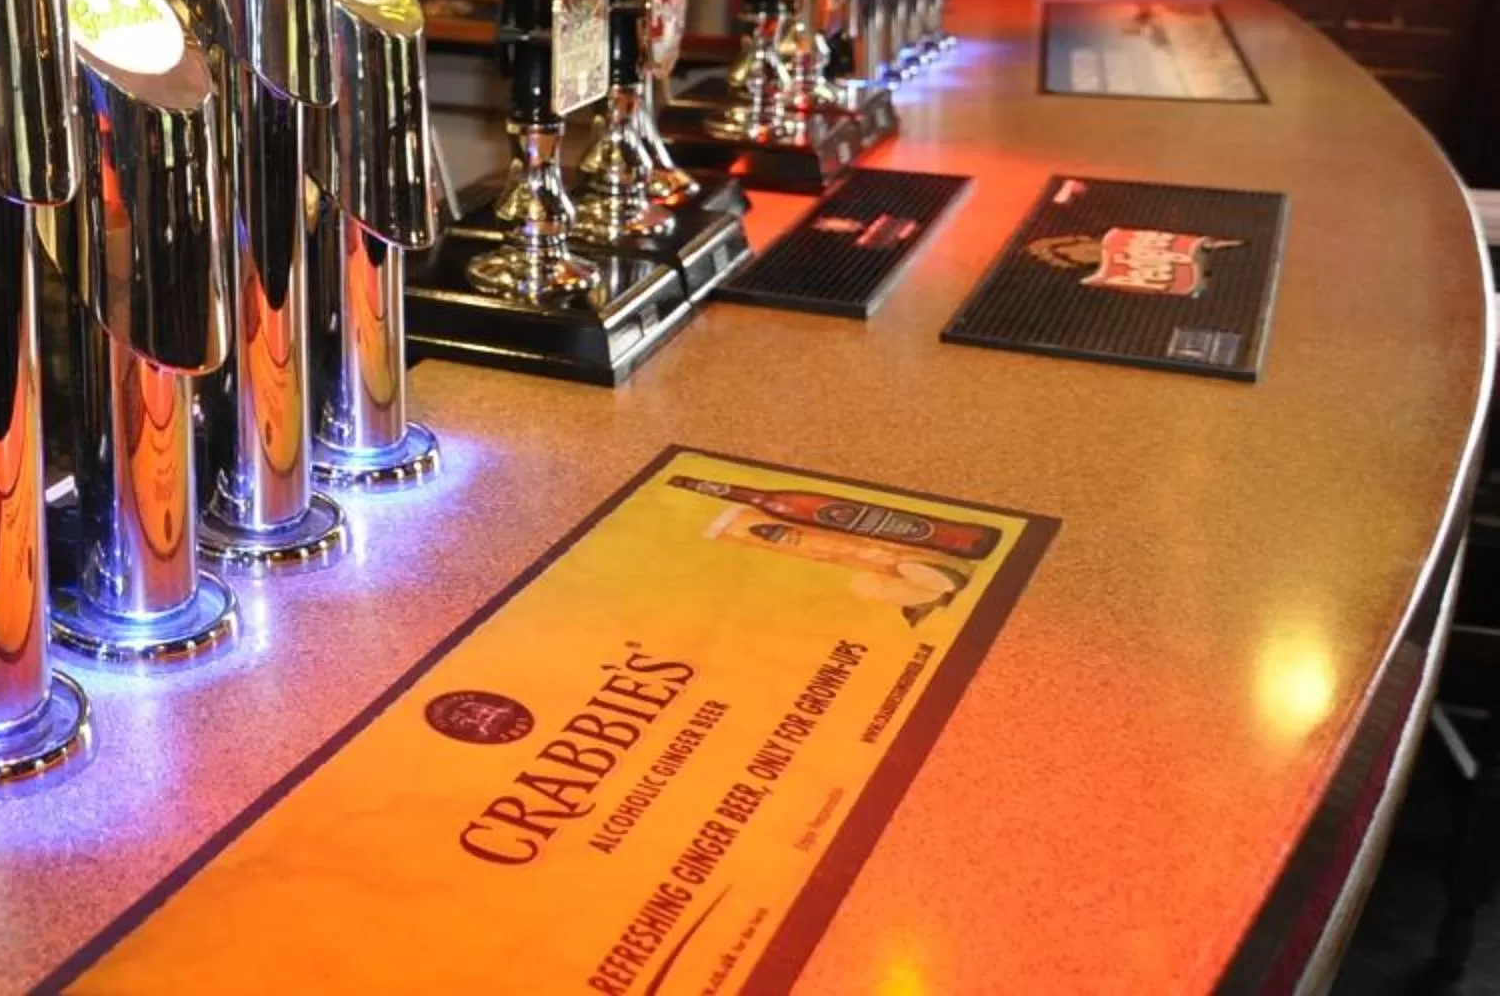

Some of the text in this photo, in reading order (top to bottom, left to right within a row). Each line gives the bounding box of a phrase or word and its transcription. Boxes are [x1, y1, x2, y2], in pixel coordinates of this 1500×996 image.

[793, 639, 869, 716] GROWN-UPS
[459, 652, 695, 866] CRABBIE'S
[745, 738, 797, 782] ONLY
[773, 712, 818, 745] FOR
[588, 699, 732, 855] ALCOHOLIC GINGER BEER
[713, 782, 774, 825] BEER,
[670, 819, 741, 886] GINGER
[587, 882, 694, 996] REFRESHING
